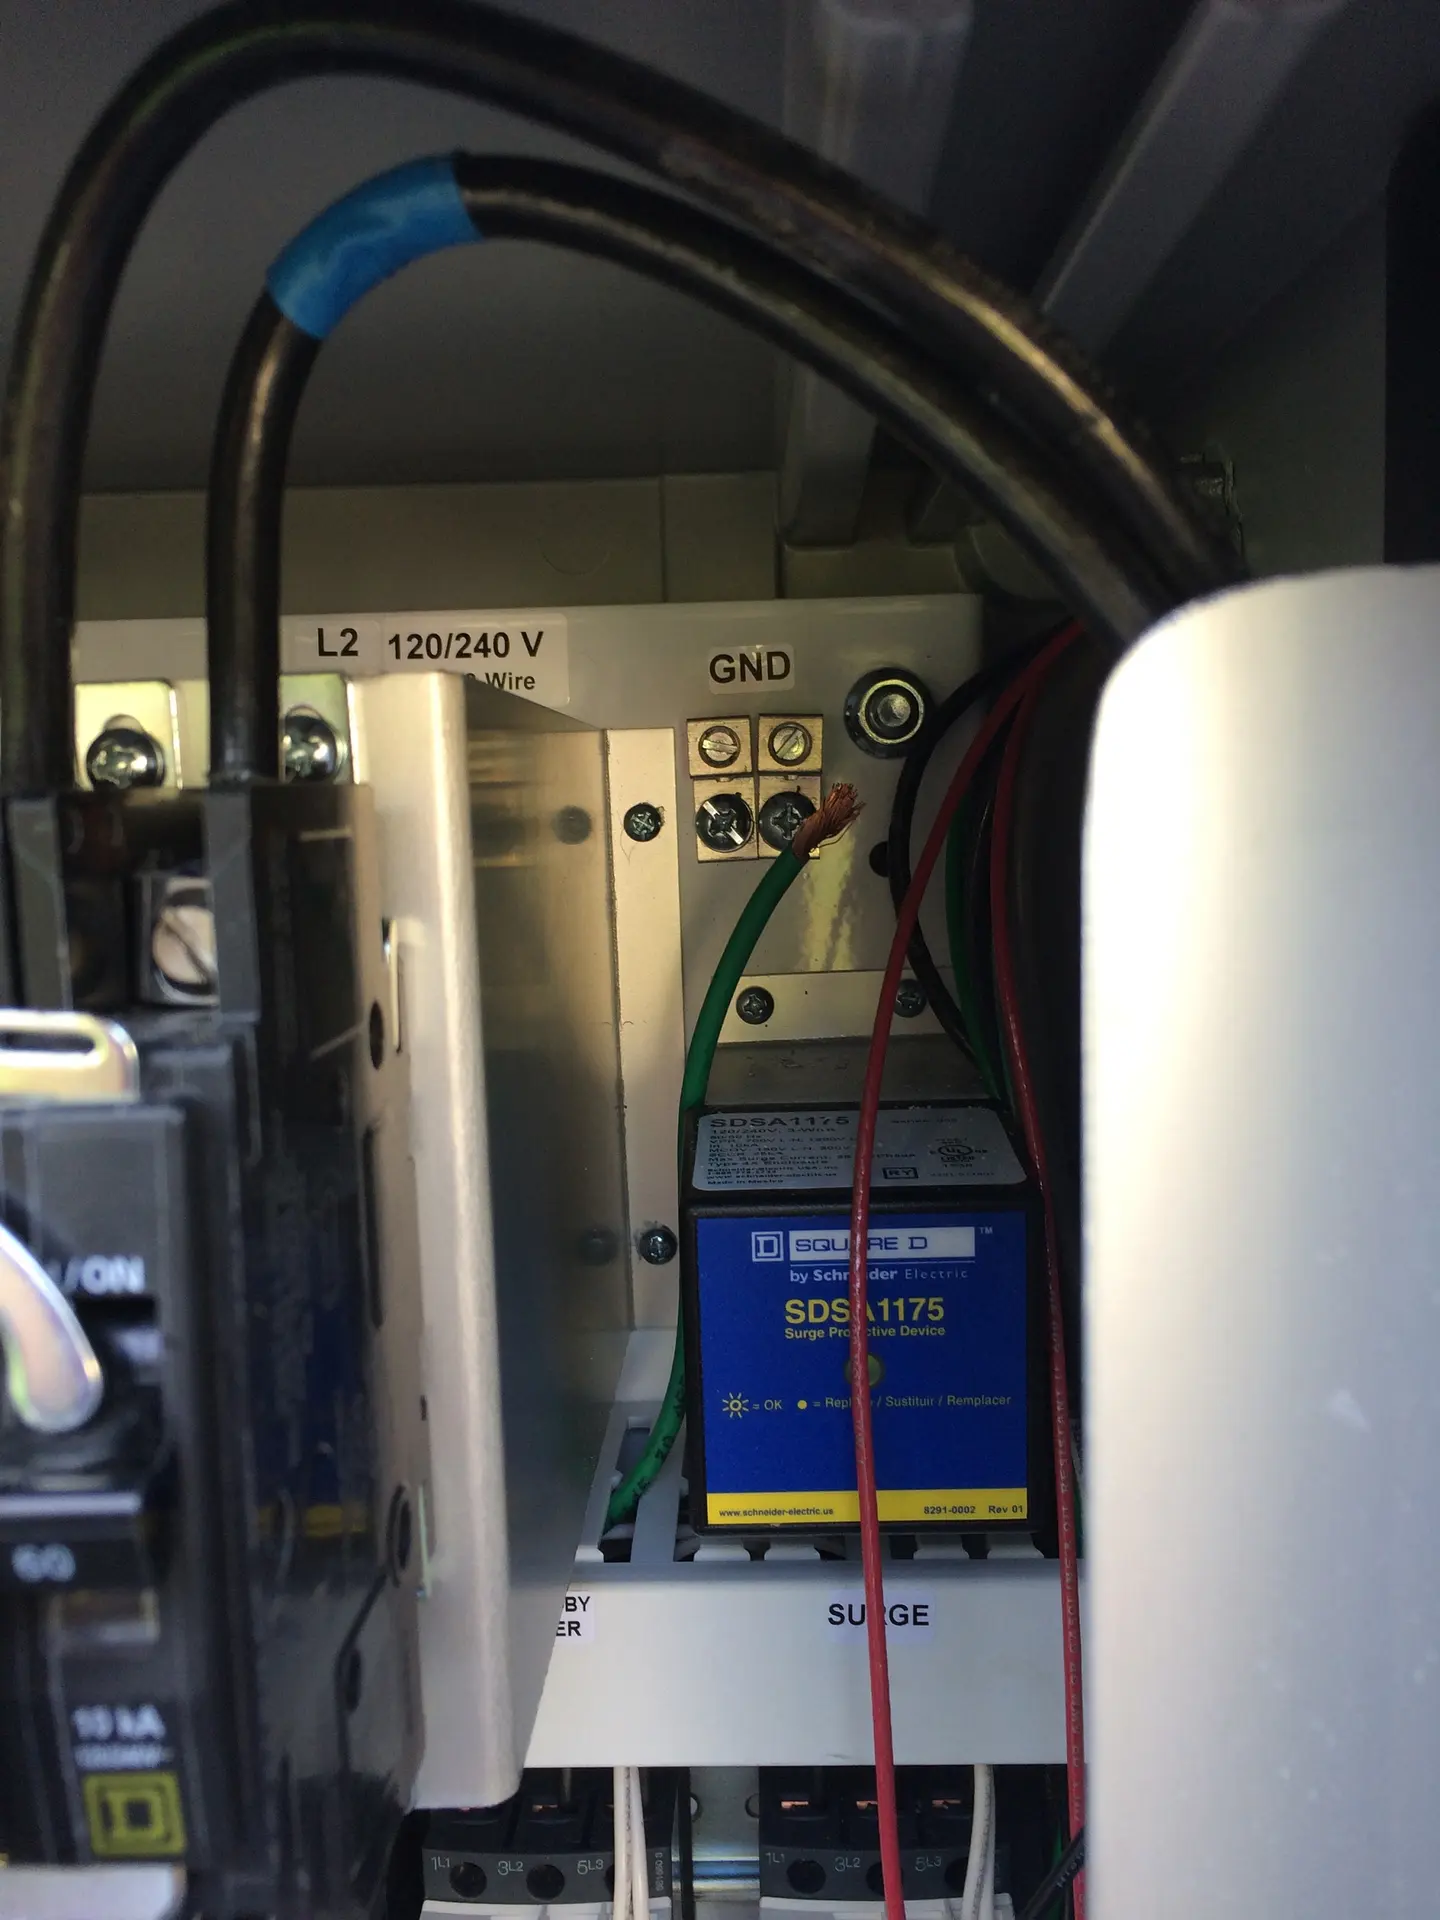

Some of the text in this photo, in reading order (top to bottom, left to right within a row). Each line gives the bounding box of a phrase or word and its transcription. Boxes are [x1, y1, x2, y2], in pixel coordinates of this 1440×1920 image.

[317, 628, 358, 657] L2
[388, 631, 544, 660] 120/240 V
[709, 651, 791, 684] GND
[485, 672, 536, 690] Wire
[710, 1116, 850, 1128] SDSA1175
[795, 1236, 928, 1252] SQURE D
[790, 1268, 969, 1284] by Schnder Electric
[785, 1324, 946, 1341] Surge Proctive Device
[764, 1399, 783, 1411] OK
[825, 1397, 874, 1410] Repl
[885, 1395, 934, 1408] Sustituir
[947, 1394, 1011, 1409] Remplacer
[718, 1505, 1024, 1517] www.schneider-electric.us 8291-0002 Rev 01
[828, 1603, 930, 1627] SUGE
[497, 1859, 524, 1876] 3L2
[576, 1858, 604, 1876] 5L3
[834, 1856, 861, 1873] 3L2
[914, 1855, 943, 1873] 5L3
